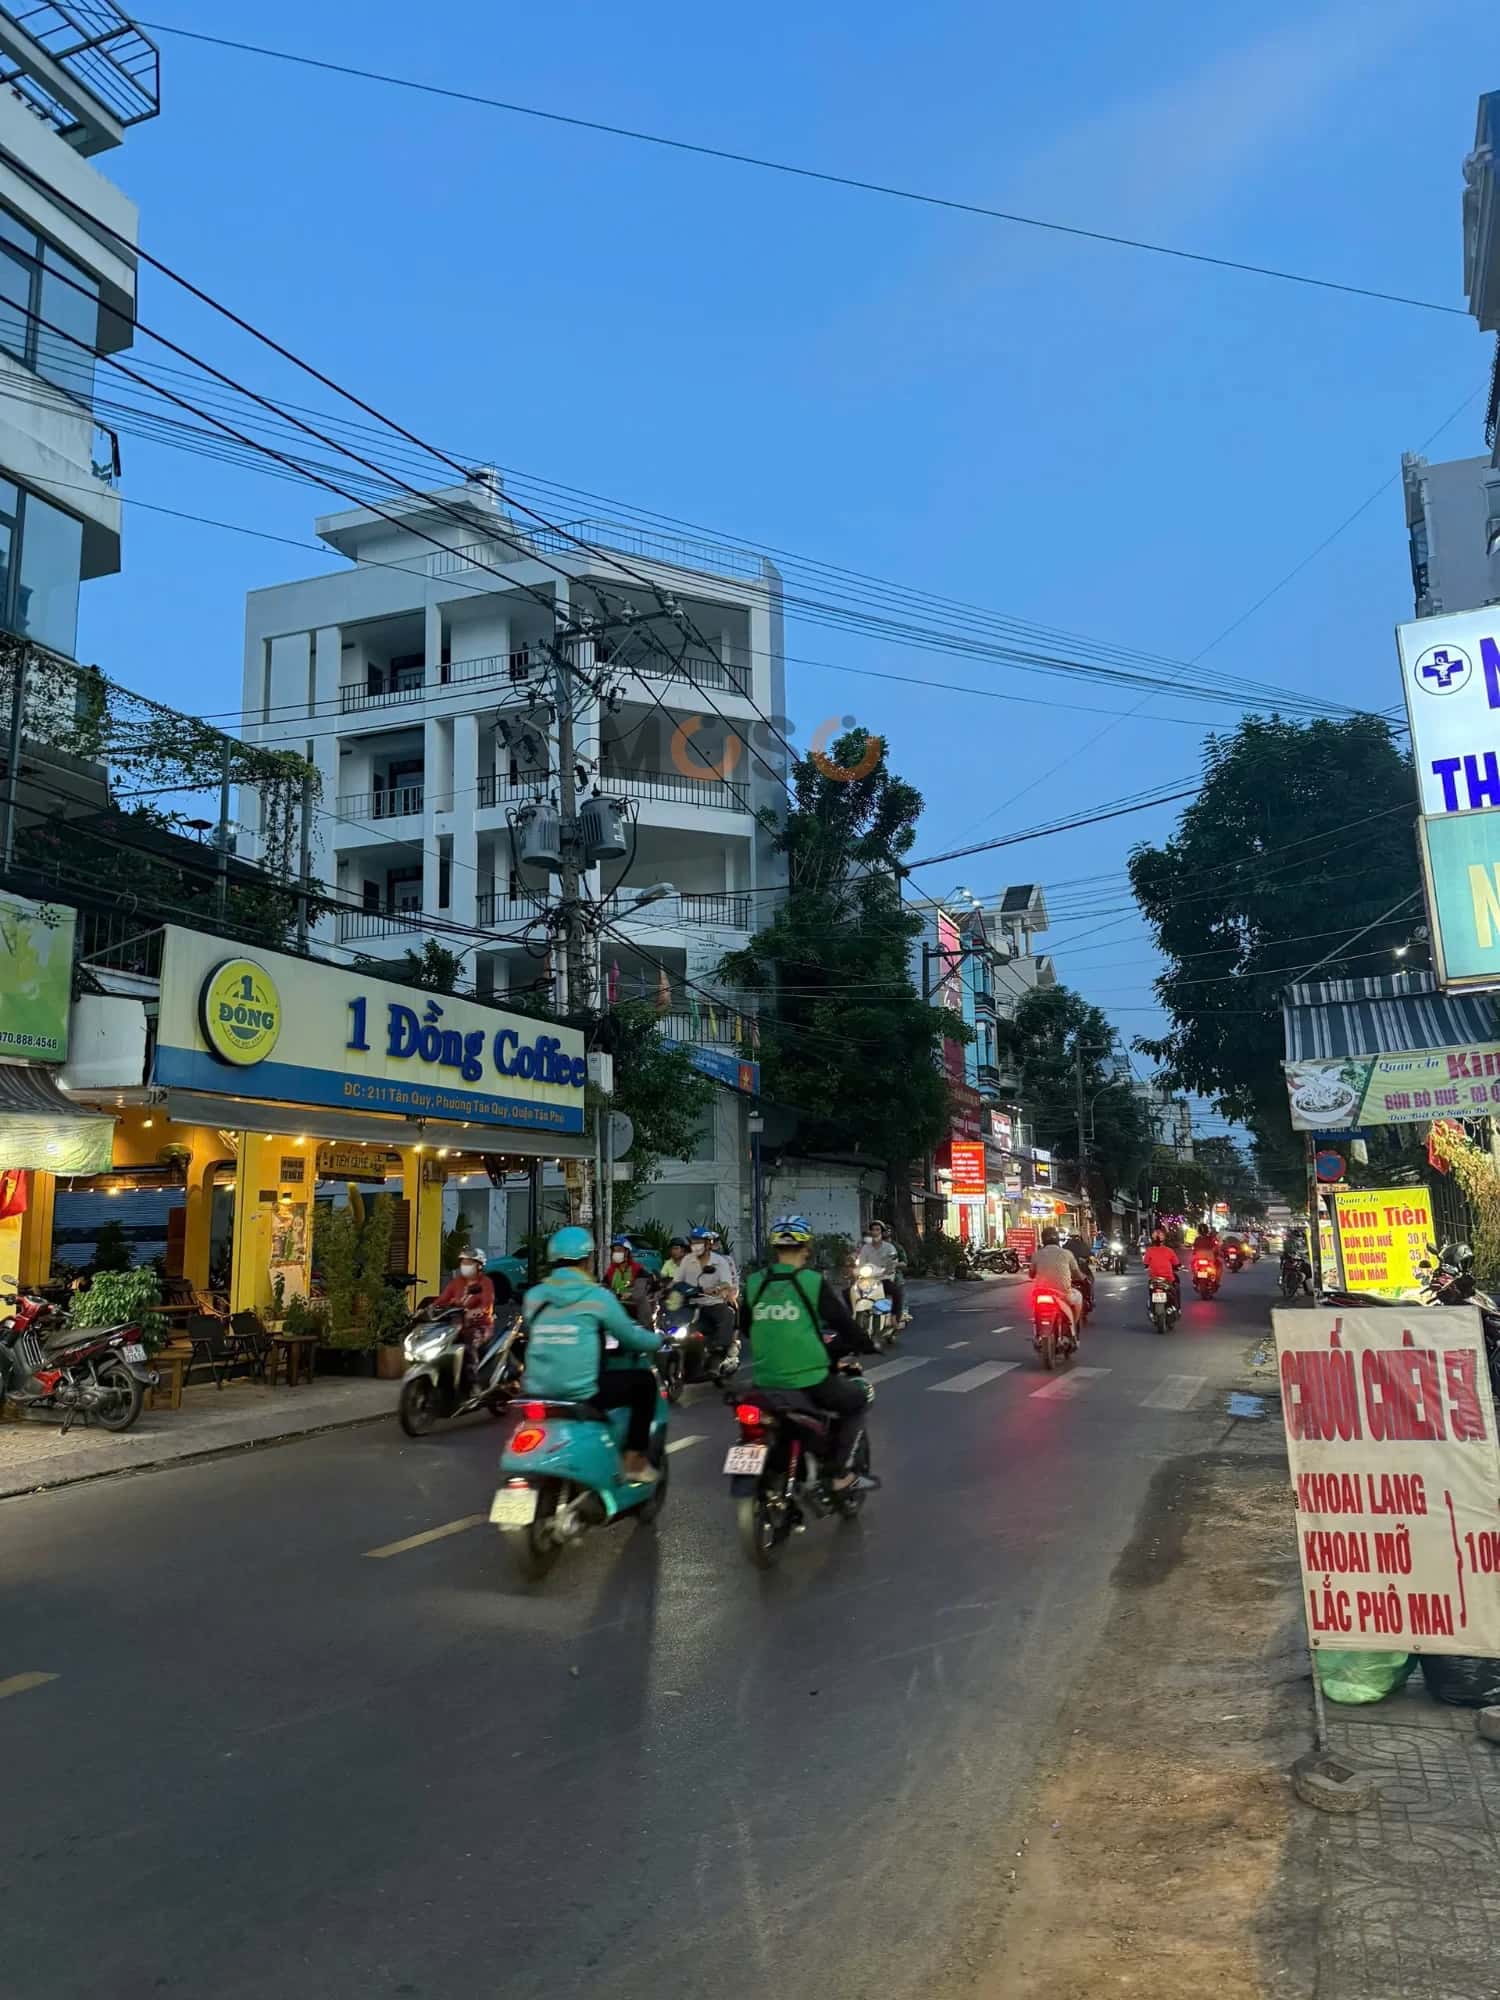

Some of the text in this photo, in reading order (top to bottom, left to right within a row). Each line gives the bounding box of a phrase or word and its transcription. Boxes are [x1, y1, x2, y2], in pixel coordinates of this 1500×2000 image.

[241, 974, 255, 1001] 1
[346, 997, 370, 1050] 1
[386, 1000, 485, 1082] Đồng
[493, 1029, 585, 1088] Coffee
[368, 1086, 386, 1100] 211
[1339, 1203, 1428, 1229] Kim Tiền
[1408, 1233, 1419, 1244] 30
[752, 1300, 801, 1321] Grab
[1281, 1318, 1488, 1442] CHUỐI CHIÊN 5K
[1298, 1473, 1428, 1515] KHOAI LANG
[1304, 1531, 1370, 1574] KHOAI
[1374, 1523, 1412, 1575] MỠ
[1309, 1574, 1454, 1636] LẮC PHÔ MAI
